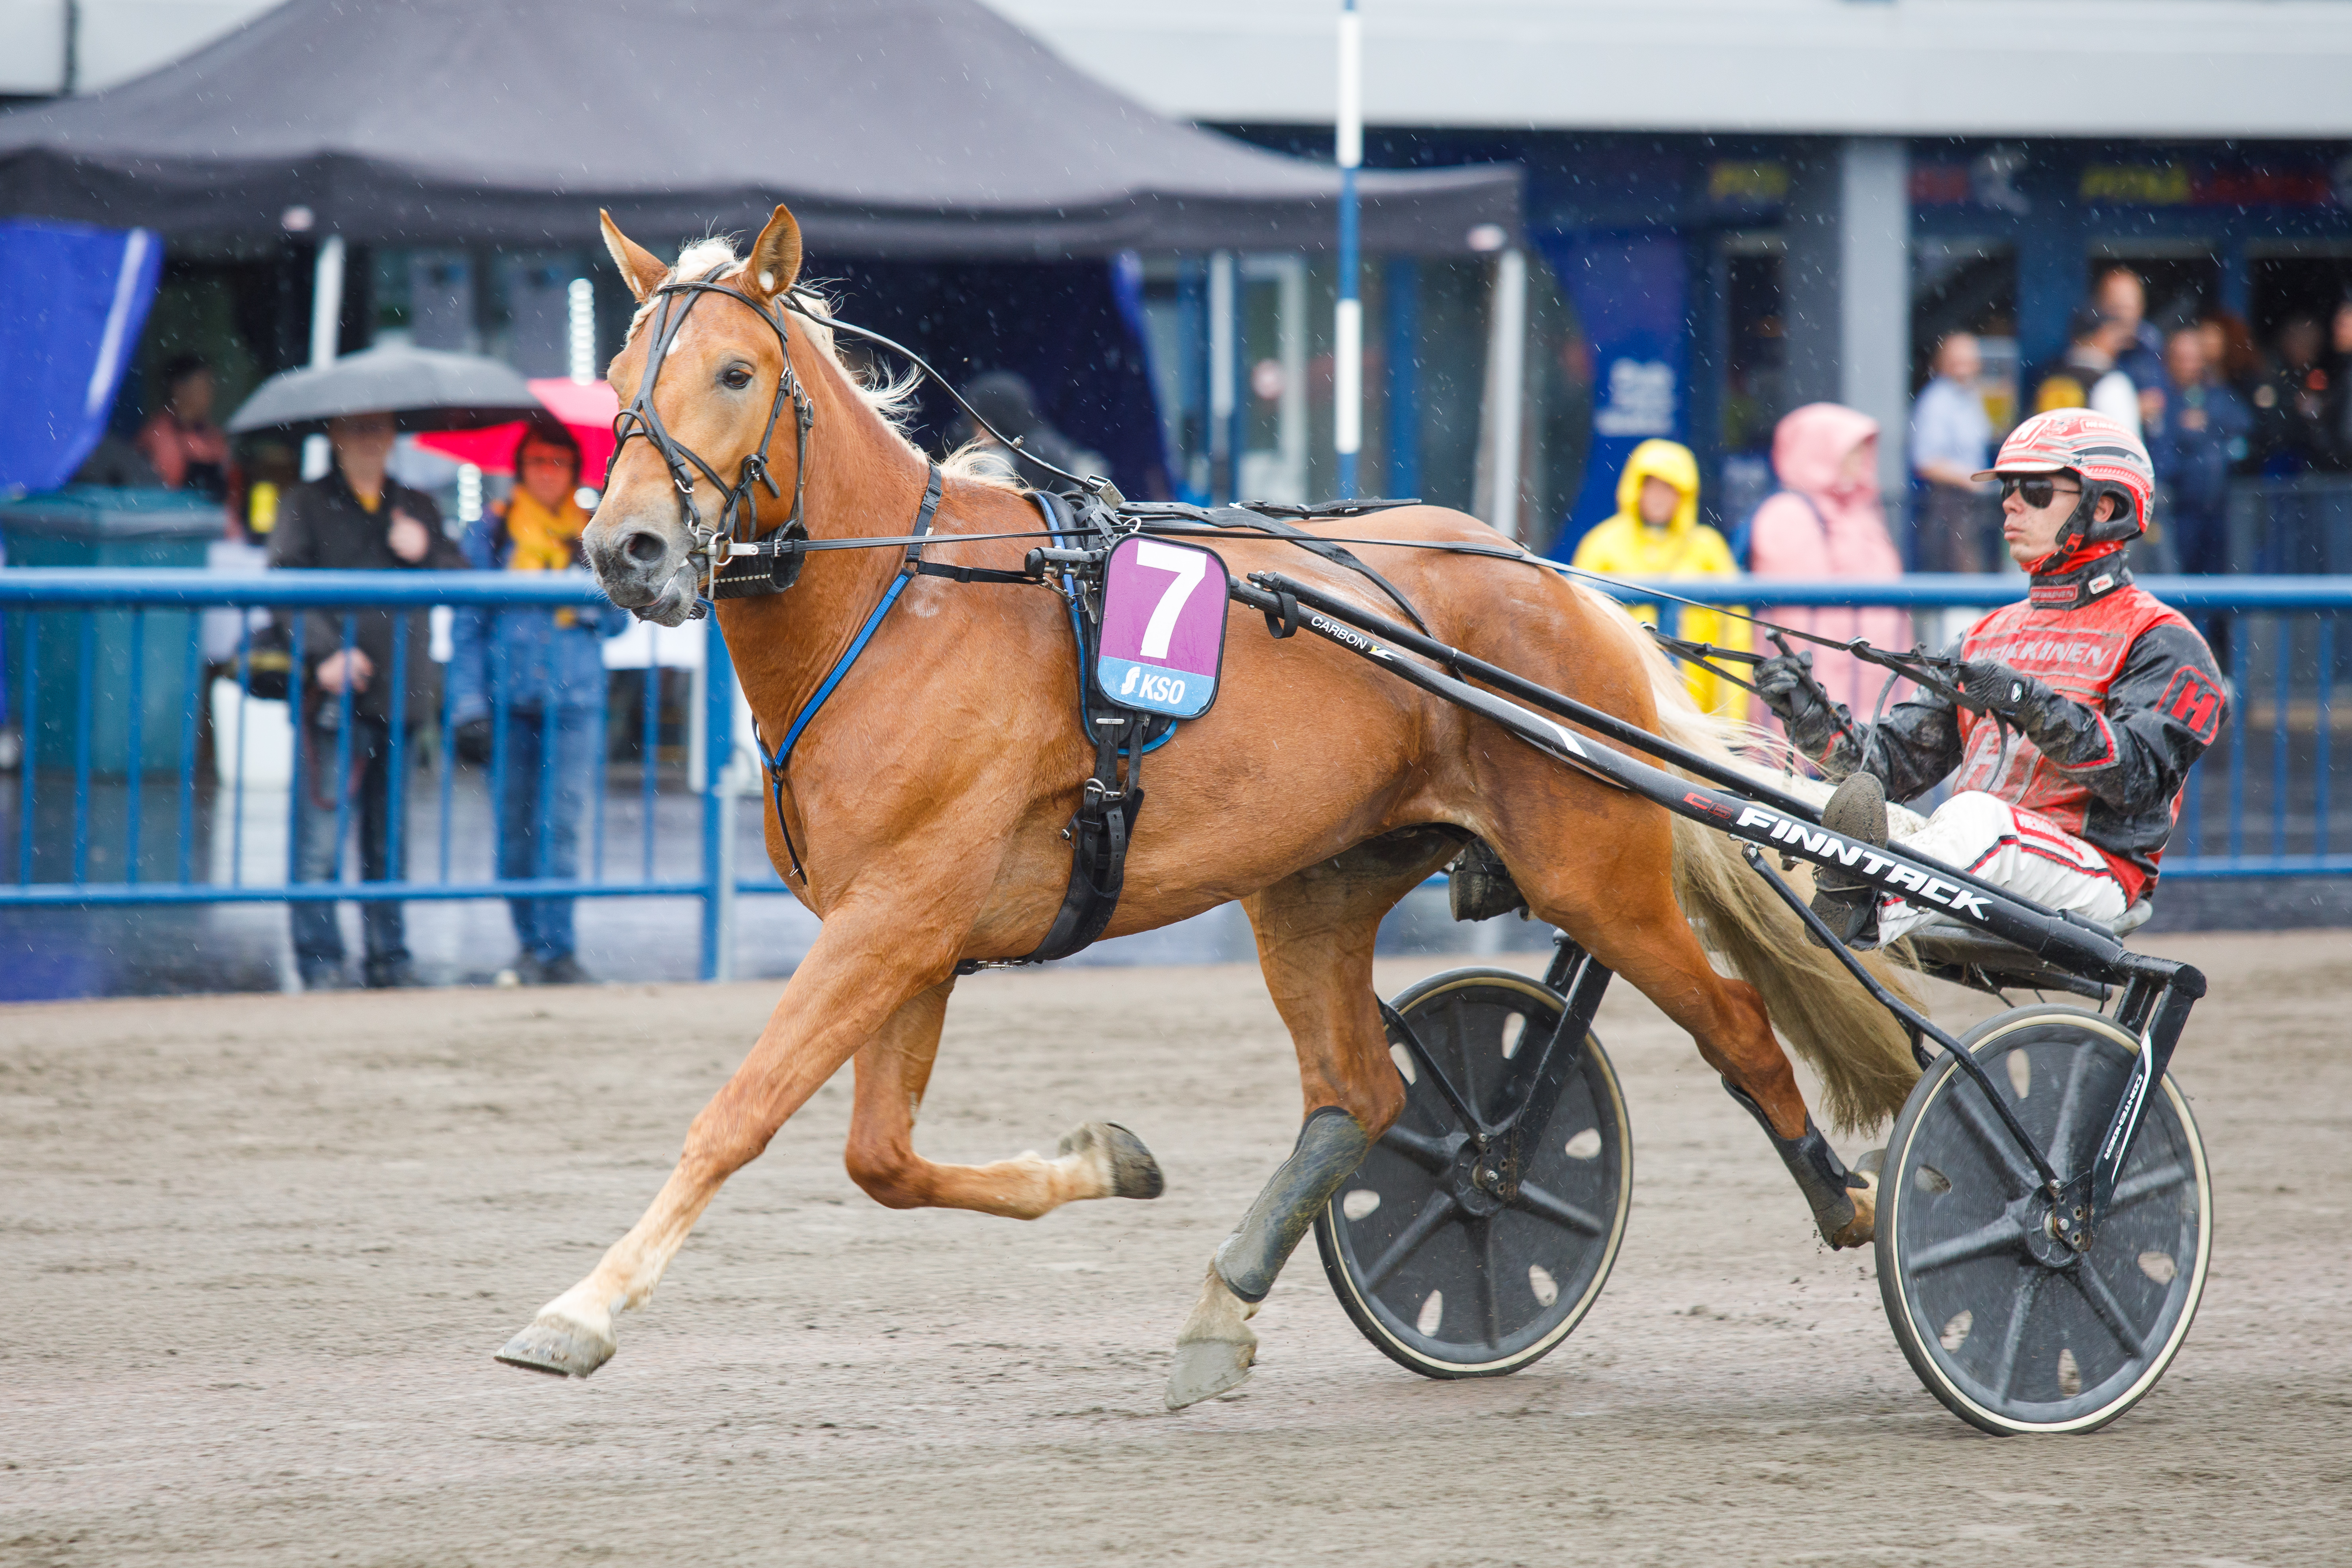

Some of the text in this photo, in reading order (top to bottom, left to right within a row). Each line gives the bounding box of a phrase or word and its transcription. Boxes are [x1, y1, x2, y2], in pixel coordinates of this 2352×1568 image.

[1136, 540, 1207, 659] 7
[1311, 616, 1368, 649] CARBON
[1139, 673, 1185, 705] KSO
[2170, 680, 2215, 732] H
[1736, 807, 1993, 920] FINNTACK
[2104, 1074, 2144, 1160] CONTENDER
